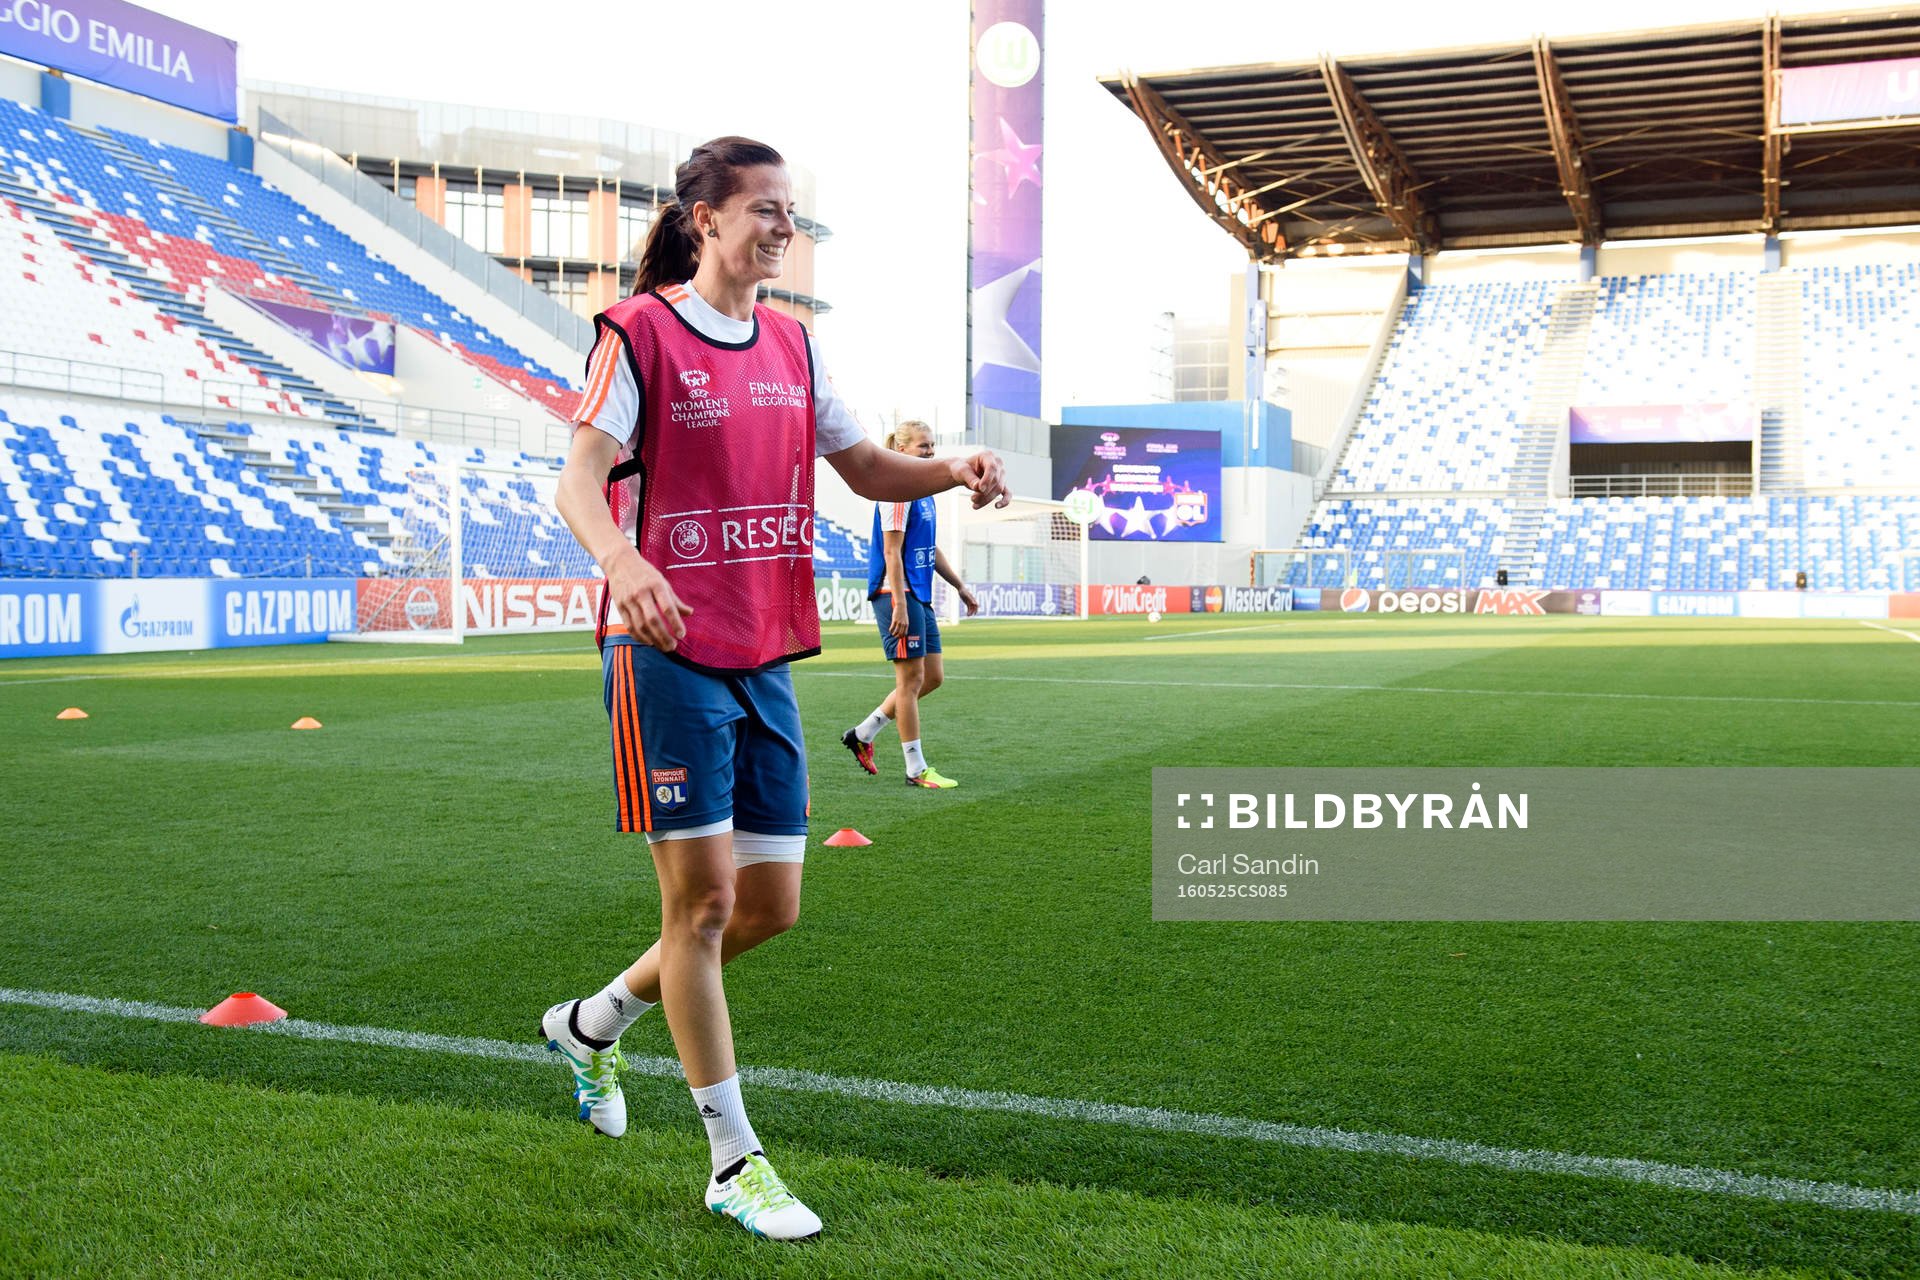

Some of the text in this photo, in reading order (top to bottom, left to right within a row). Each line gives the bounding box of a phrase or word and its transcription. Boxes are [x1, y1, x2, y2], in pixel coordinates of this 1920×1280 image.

[88, 19, 195, 83] EMILIA
[749, 381, 787, 395] FINAL
[671, 397, 729, 412] WOMEN'S
[752, 396, 787, 407] REGGIO
[671, 408, 731, 422] CHAMPIONS
[676, 523, 699, 533] UEFA
[1115, 586, 1167, 613] UniCredit
[1224, 586, 1293, 613] MasterCard
[1378, 589, 1467, 613] pepsi
[1473, 589, 1552, 614] MAX
[226, 589, 351, 636] GAZPROM
[141, 620, 193, 637] GAZPROM
